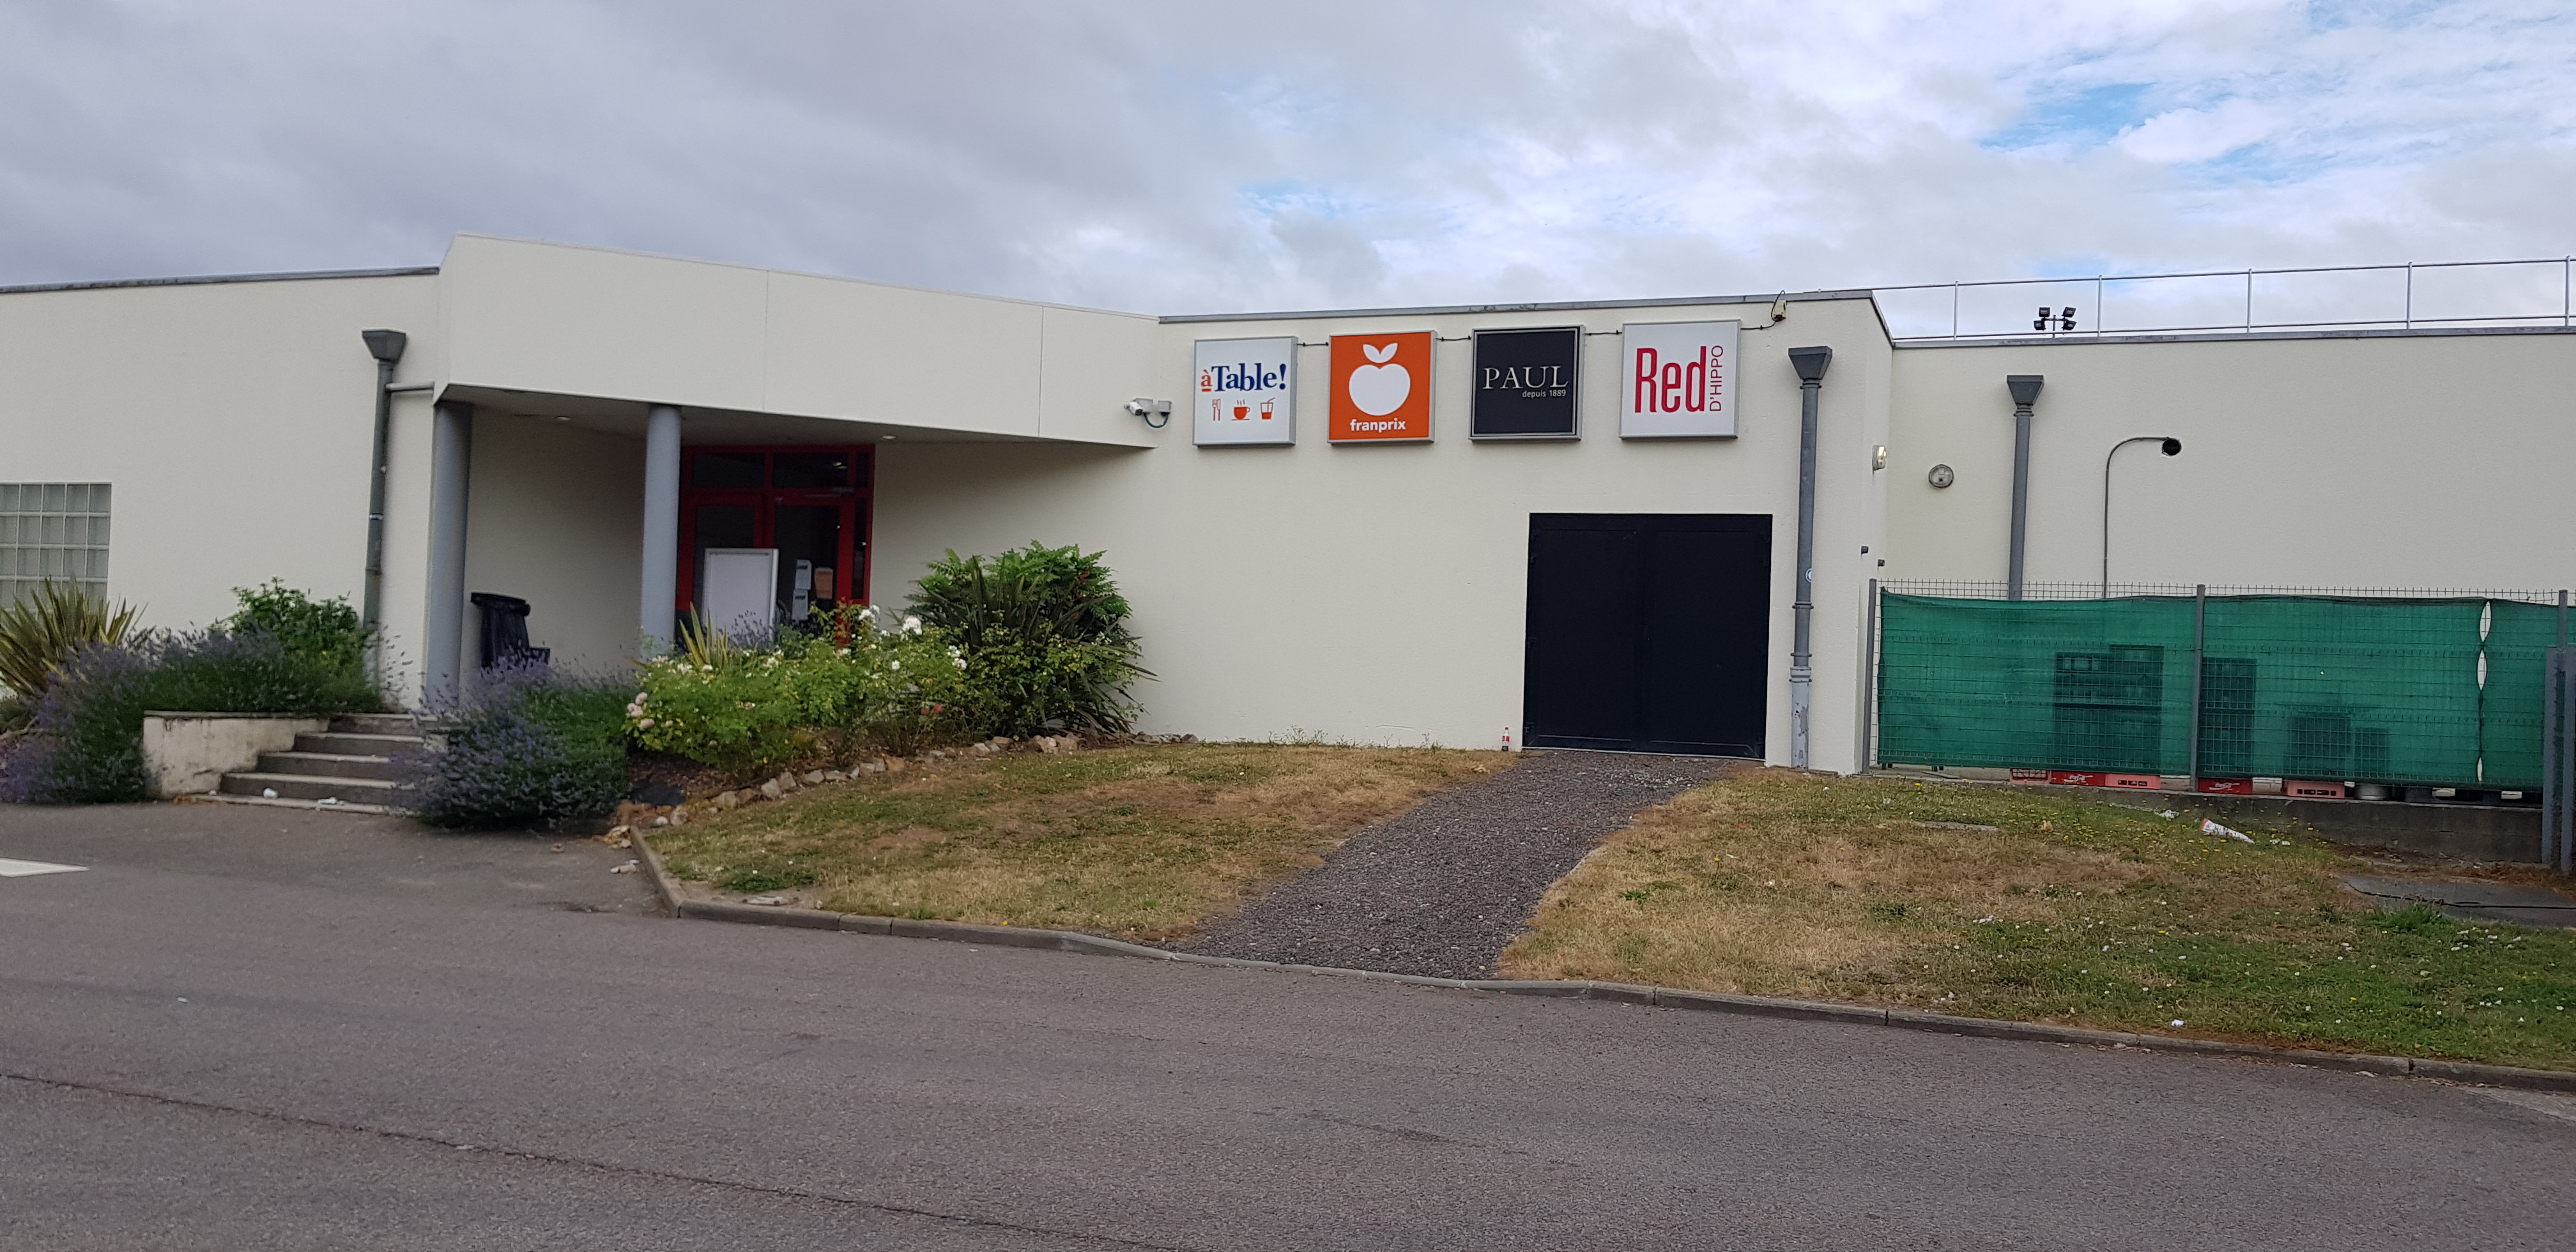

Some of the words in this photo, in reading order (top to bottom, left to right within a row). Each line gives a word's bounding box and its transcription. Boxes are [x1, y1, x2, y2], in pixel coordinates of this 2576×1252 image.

[1212, 363, 1287, 391] Table!
[1482, 365, 1568, 390] PAUL
[1634, 346, 1706, 413] Red
[1710, 345, 1723, 411] D'HIPPO
[1522, 390, 1546, 399] depuis
[1350, 417, 1406, 432] franprix
